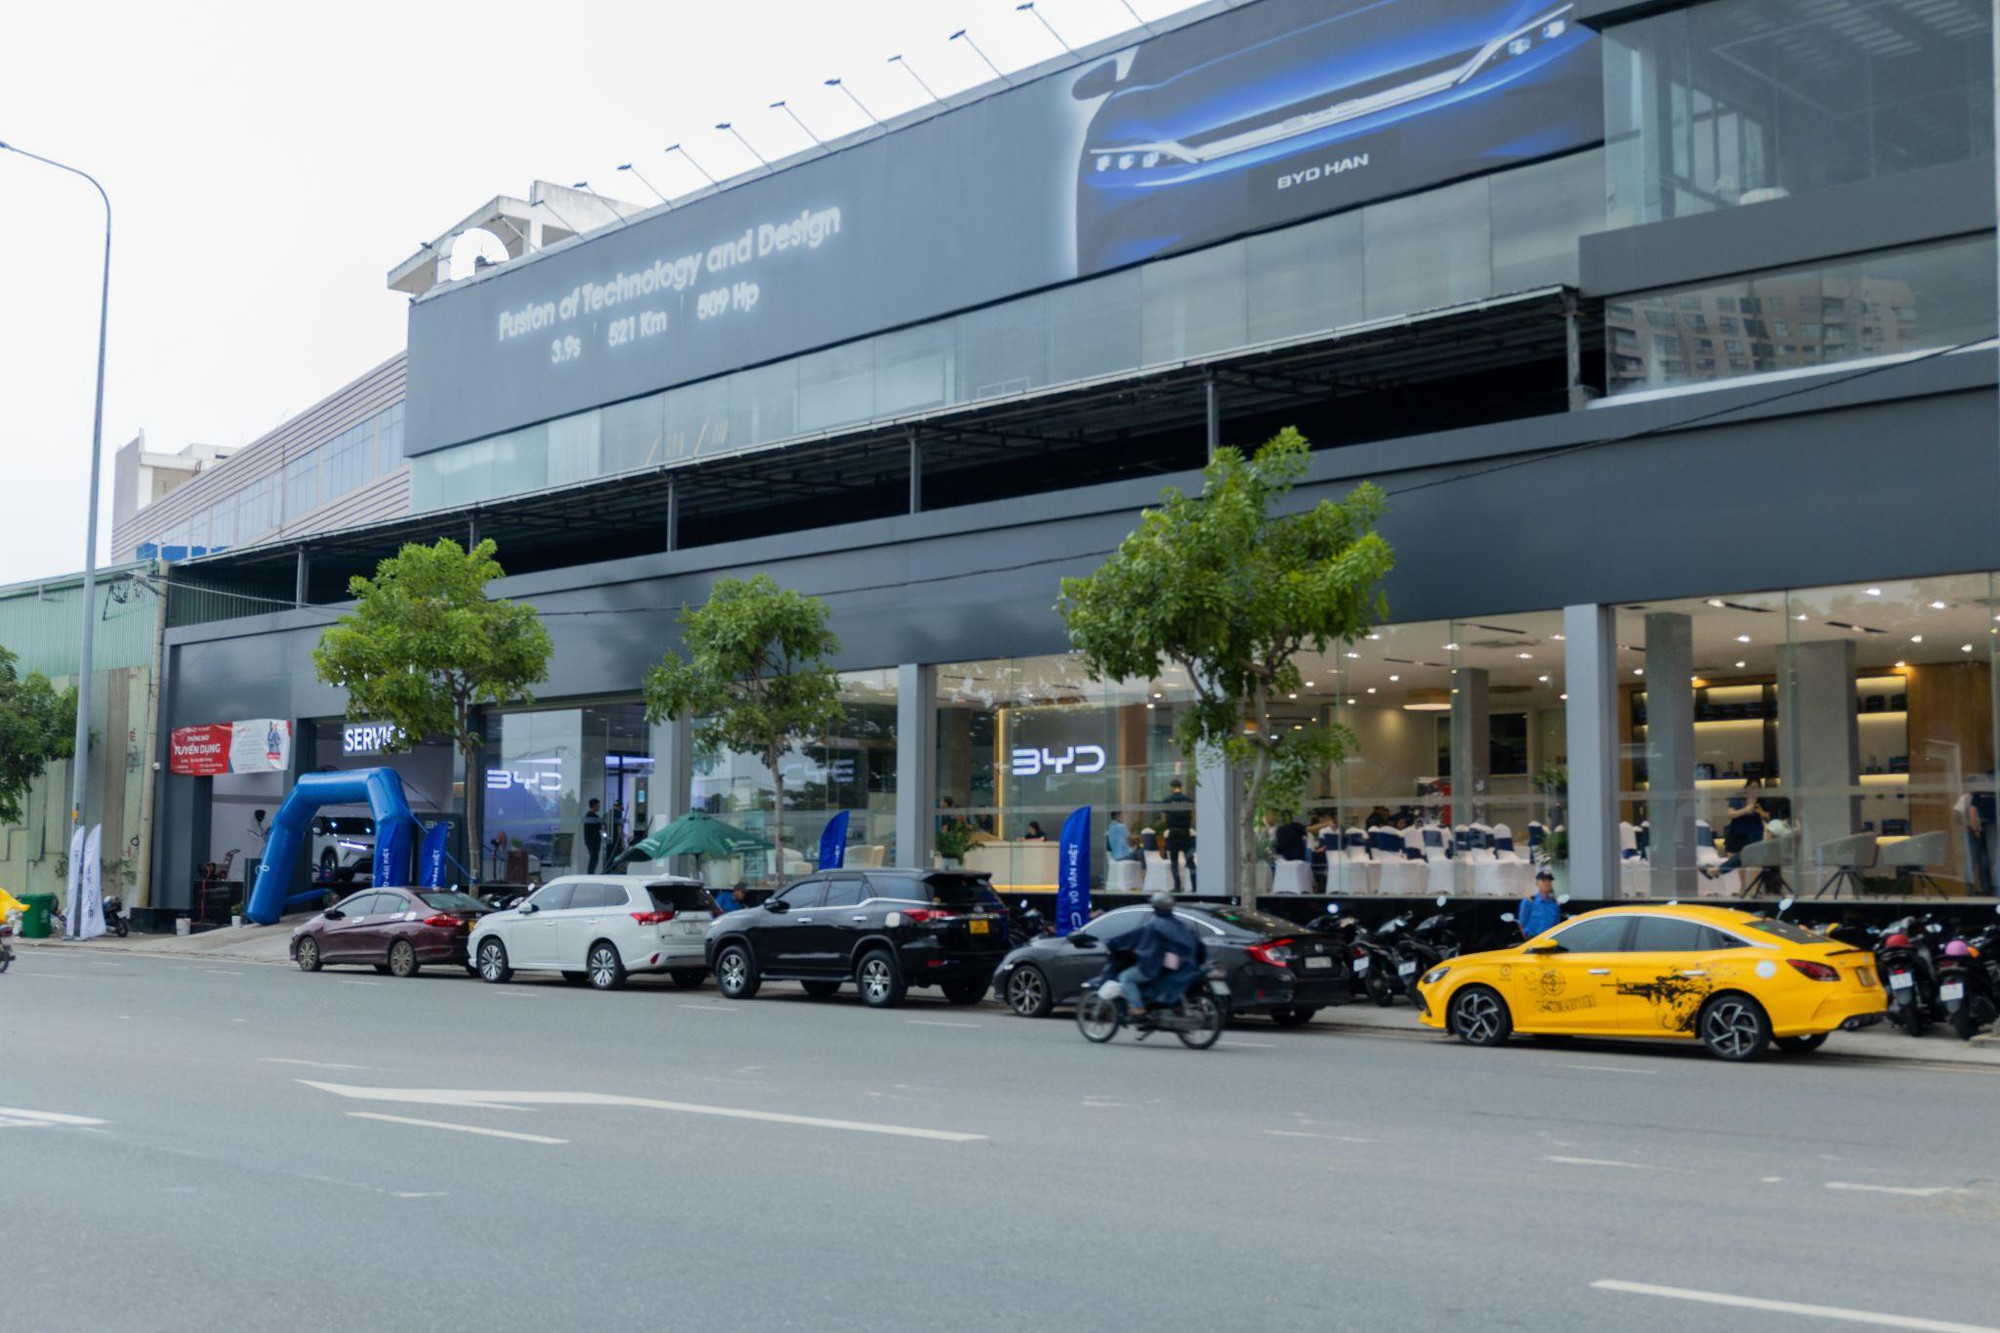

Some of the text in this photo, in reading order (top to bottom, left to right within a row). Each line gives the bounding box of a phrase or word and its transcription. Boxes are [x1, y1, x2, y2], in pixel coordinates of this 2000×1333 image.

[1277, 152, 1369, 190] BYD HAN
[499, 206, 841, 341] Fusion of Technology and Design
[551, 334, 581, 363] 3.9s
[608, 316, 635, 347] 521
[640, 310, 667, 338] Km
[733, 281, 759, 311] Hp
[1012, 745, 1105, 775] BYD
[487, 770, 562, 790] BYD
